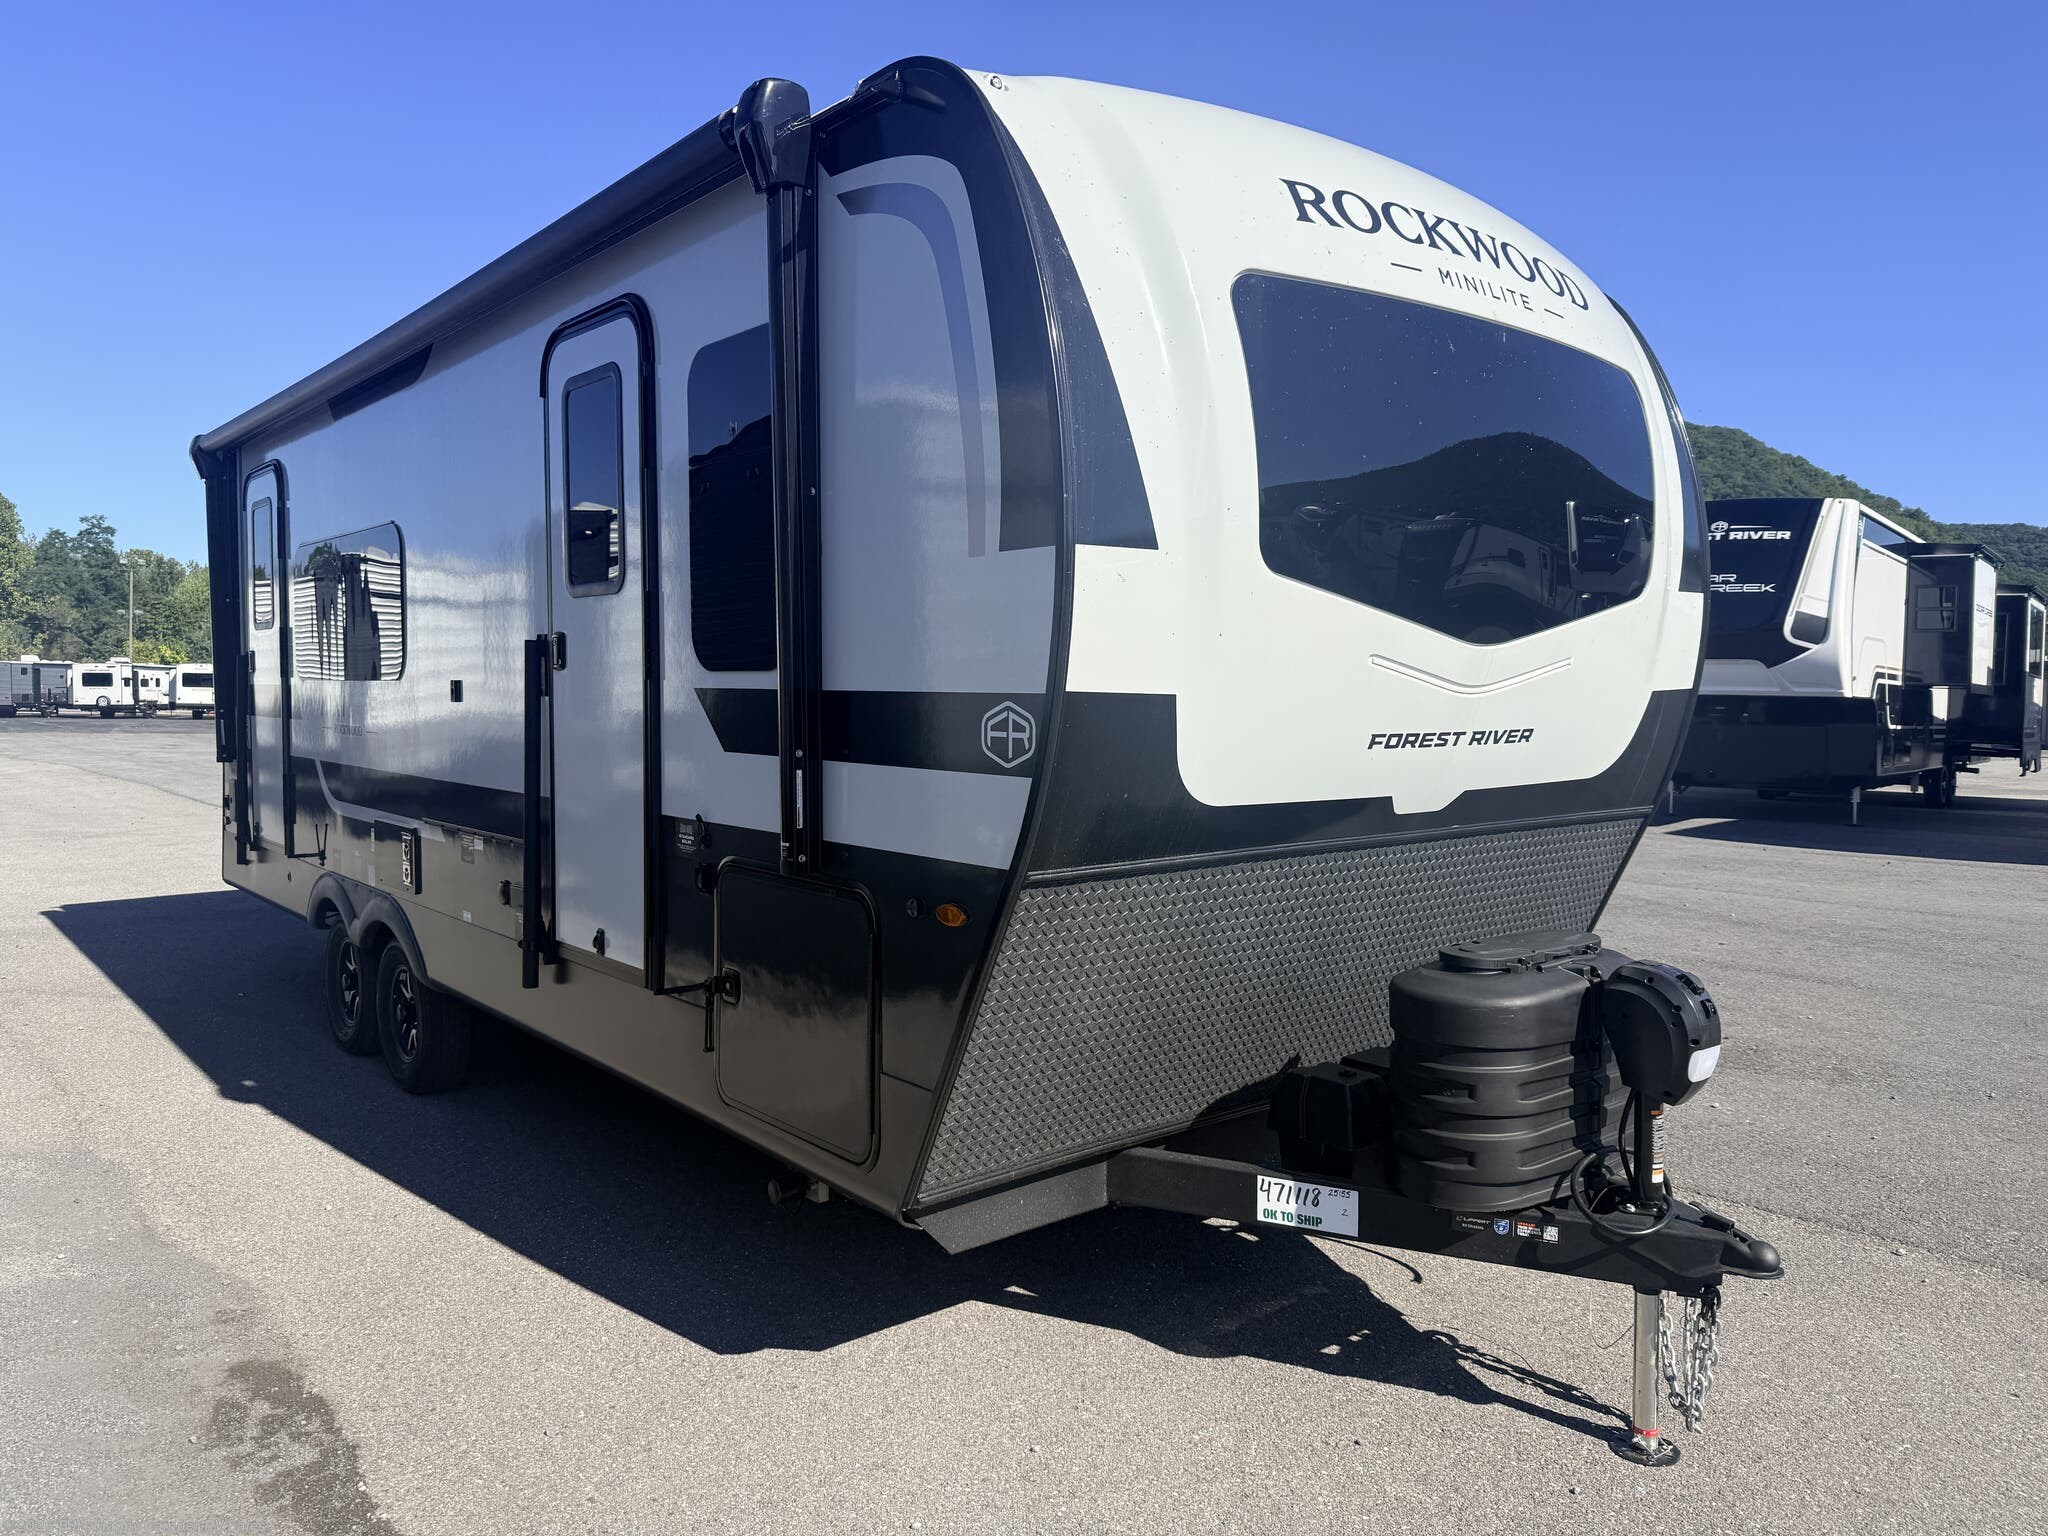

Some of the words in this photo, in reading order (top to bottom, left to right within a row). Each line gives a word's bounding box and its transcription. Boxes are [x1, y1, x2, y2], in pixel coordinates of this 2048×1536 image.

[1279, 178, 1589, 311] ROCKWOOD
[1438, 266, 1534, 312] MINILITE
[1728, 531, 1791, 540] RIVER
[1710, 583, 1776, 593] REEK
[1367, 731, 1467, 750] FOREST
[1468, 728, 1535, 746] RIVER
[1259, 1178, 1322, 1208] 471118
[1263, 1208, 1278, 1220] OK
[1281, 1211, 1294, 1223] TO
[1296, 1213, 1323, 1228] SHIP
[1341, 1208, 1349, 1217] 2
